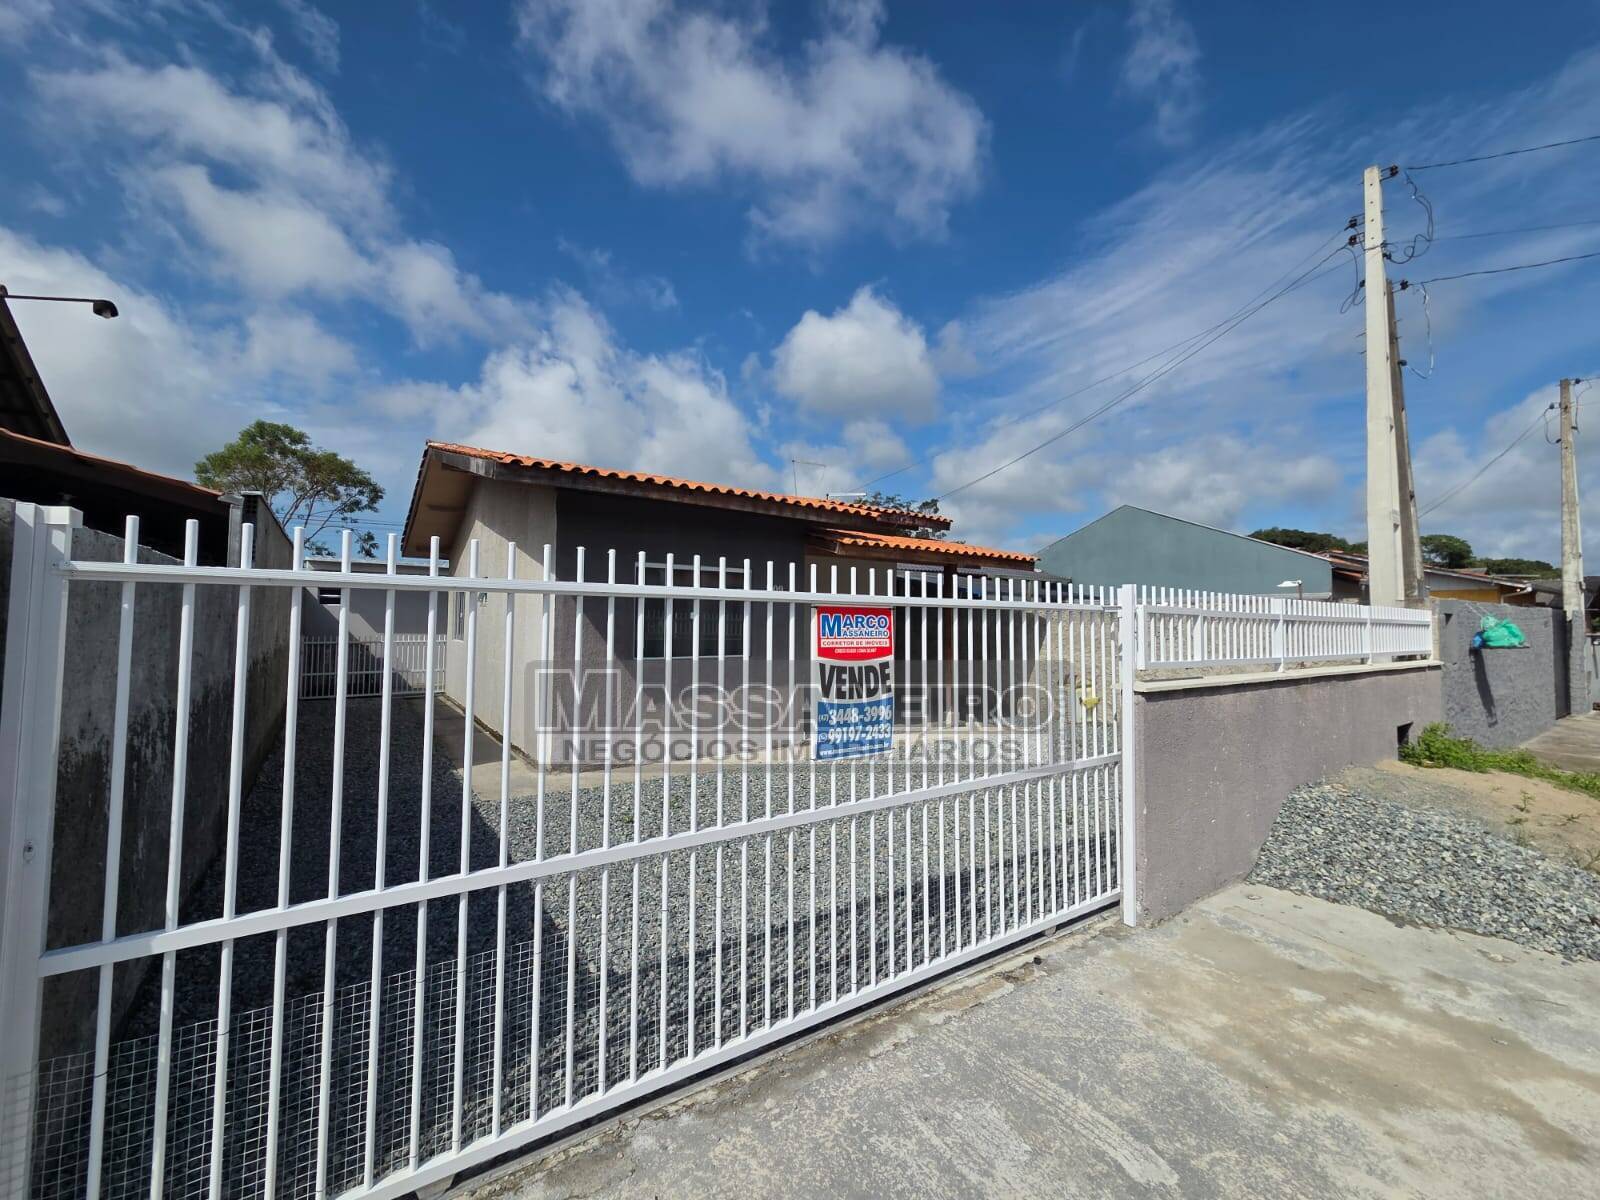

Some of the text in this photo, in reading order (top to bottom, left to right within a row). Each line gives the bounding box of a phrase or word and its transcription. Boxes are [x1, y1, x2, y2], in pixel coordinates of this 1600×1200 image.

[820, 613, 888, 637] MARCO
[819, 662, 892, 699] VENDE
[829, 705, 892, 725] 3448-3996
[828, 723, 891, 744] 99197-2433
